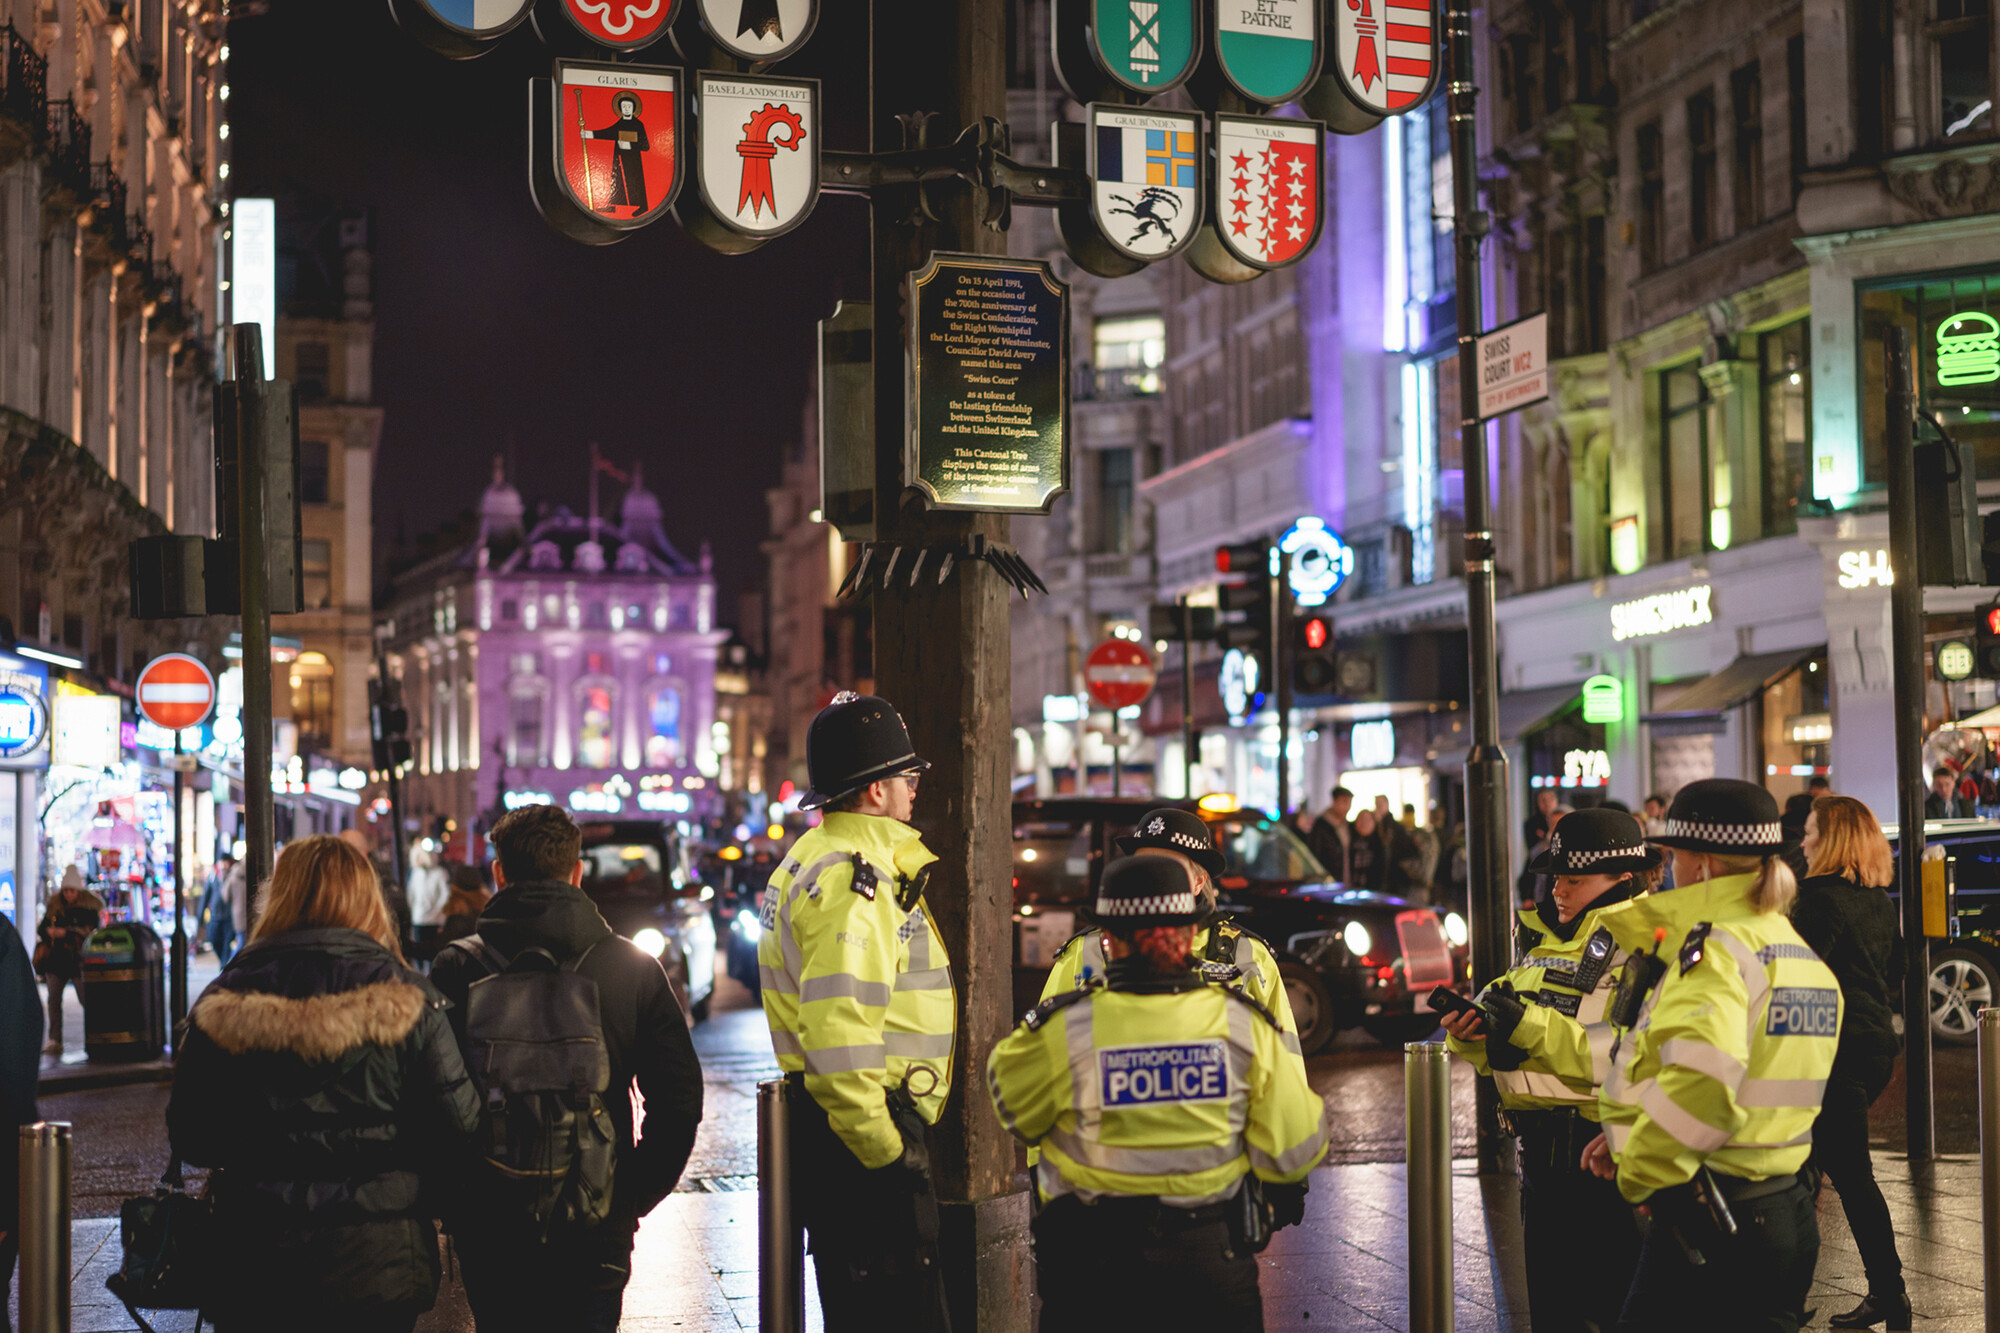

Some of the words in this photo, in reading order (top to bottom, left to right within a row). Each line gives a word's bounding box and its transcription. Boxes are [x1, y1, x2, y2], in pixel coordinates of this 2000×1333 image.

[1257, 0, 1278, 13] ET
[1241, 10, 1292, 30] PATRIE
[598, 75, 638, 86] GLARUS
[707, 84, 808, 100] BASEL-LANDSCHAFT
[1115, 116, 1177, 129] GRAUBÜNDEN
[1255, 128, 1285, 138] VALAIS
[958, 275, 971, 284] On
[983, 278, 1003, 288] April
[1005, 279, 1023, 289] 1991,
[968, 288, 980, 296] the
[982, 290, 1015, 299] occasion
[1017, 291, 1025, 299] of
[945, 299, 957, 307] the
[959, 300, 980, 308] 700th
[981, 303, 1026, 313] anniversary
[1028, 304, 1037, 312] of
[943, 310, 955, 319] the
[957, 311, 980, 320] Swiss
[982, 313, 1039, 325] Confederation,
[951, 323, 962, 331] the
[964, 323, 986, 334] Right
[988, 325, 1031, 336] Worshipful
[931, 333, 943, 341] the
[945, 334, 963, 343] Lord
[965, 335, 990, 346] Mayor
[992, 336, 1000, 345] of
[1002, 337, 1050, 349] Westminster,
[1484, 335, 1510, 361] SWISS
[946, 346, 986, 356] Councillor
[989, 348, 1011, 357] David
[1013, 350, 1036, 361] Avery
[961, 360, 987, 368] named
[989, 361, 1003, 369] this
[1484, 358, 1511, 385] COURT
[1513, 350, 1531, 373] WC2
[984, 391, 1005, 400] token
[1007, 392, 1015, 400] of
[950, 401, 962, 409] the
[964, 402, 990, 413] lasting
[992, 403, 1032, 415] friendship
[951, 413, 984, 422] between
[986, 414, 1031, 425] Switzerland
[959, 425, 971, 433] the
[973, 426, 999, 435] United
[1001, 427, 1039, 438] Kingdom.
[954, 448, 972, 457] This
[974, 449, 1009, 459] Cantonal
[1011, 451, 1028, 460] Tree
[942, 460, 974, 471] displays
[976, 461, 988, 469] the
[990, 463, 1009, 471] coats
[1011, 463, 1020, 472] of
[954, 473, 965, 481] the
[1839, 549, 1894, 589] SH
[836, 931, 869, 951] POLICE
[1772, 989, 1837, 1005] METROPOLITAN
[1768, 1004, 1837, 1034] POLICE
[1107, 1047, 1220, 1069] METROPOLITAN
[1109, 1065, 1221, 1102] POLICE
